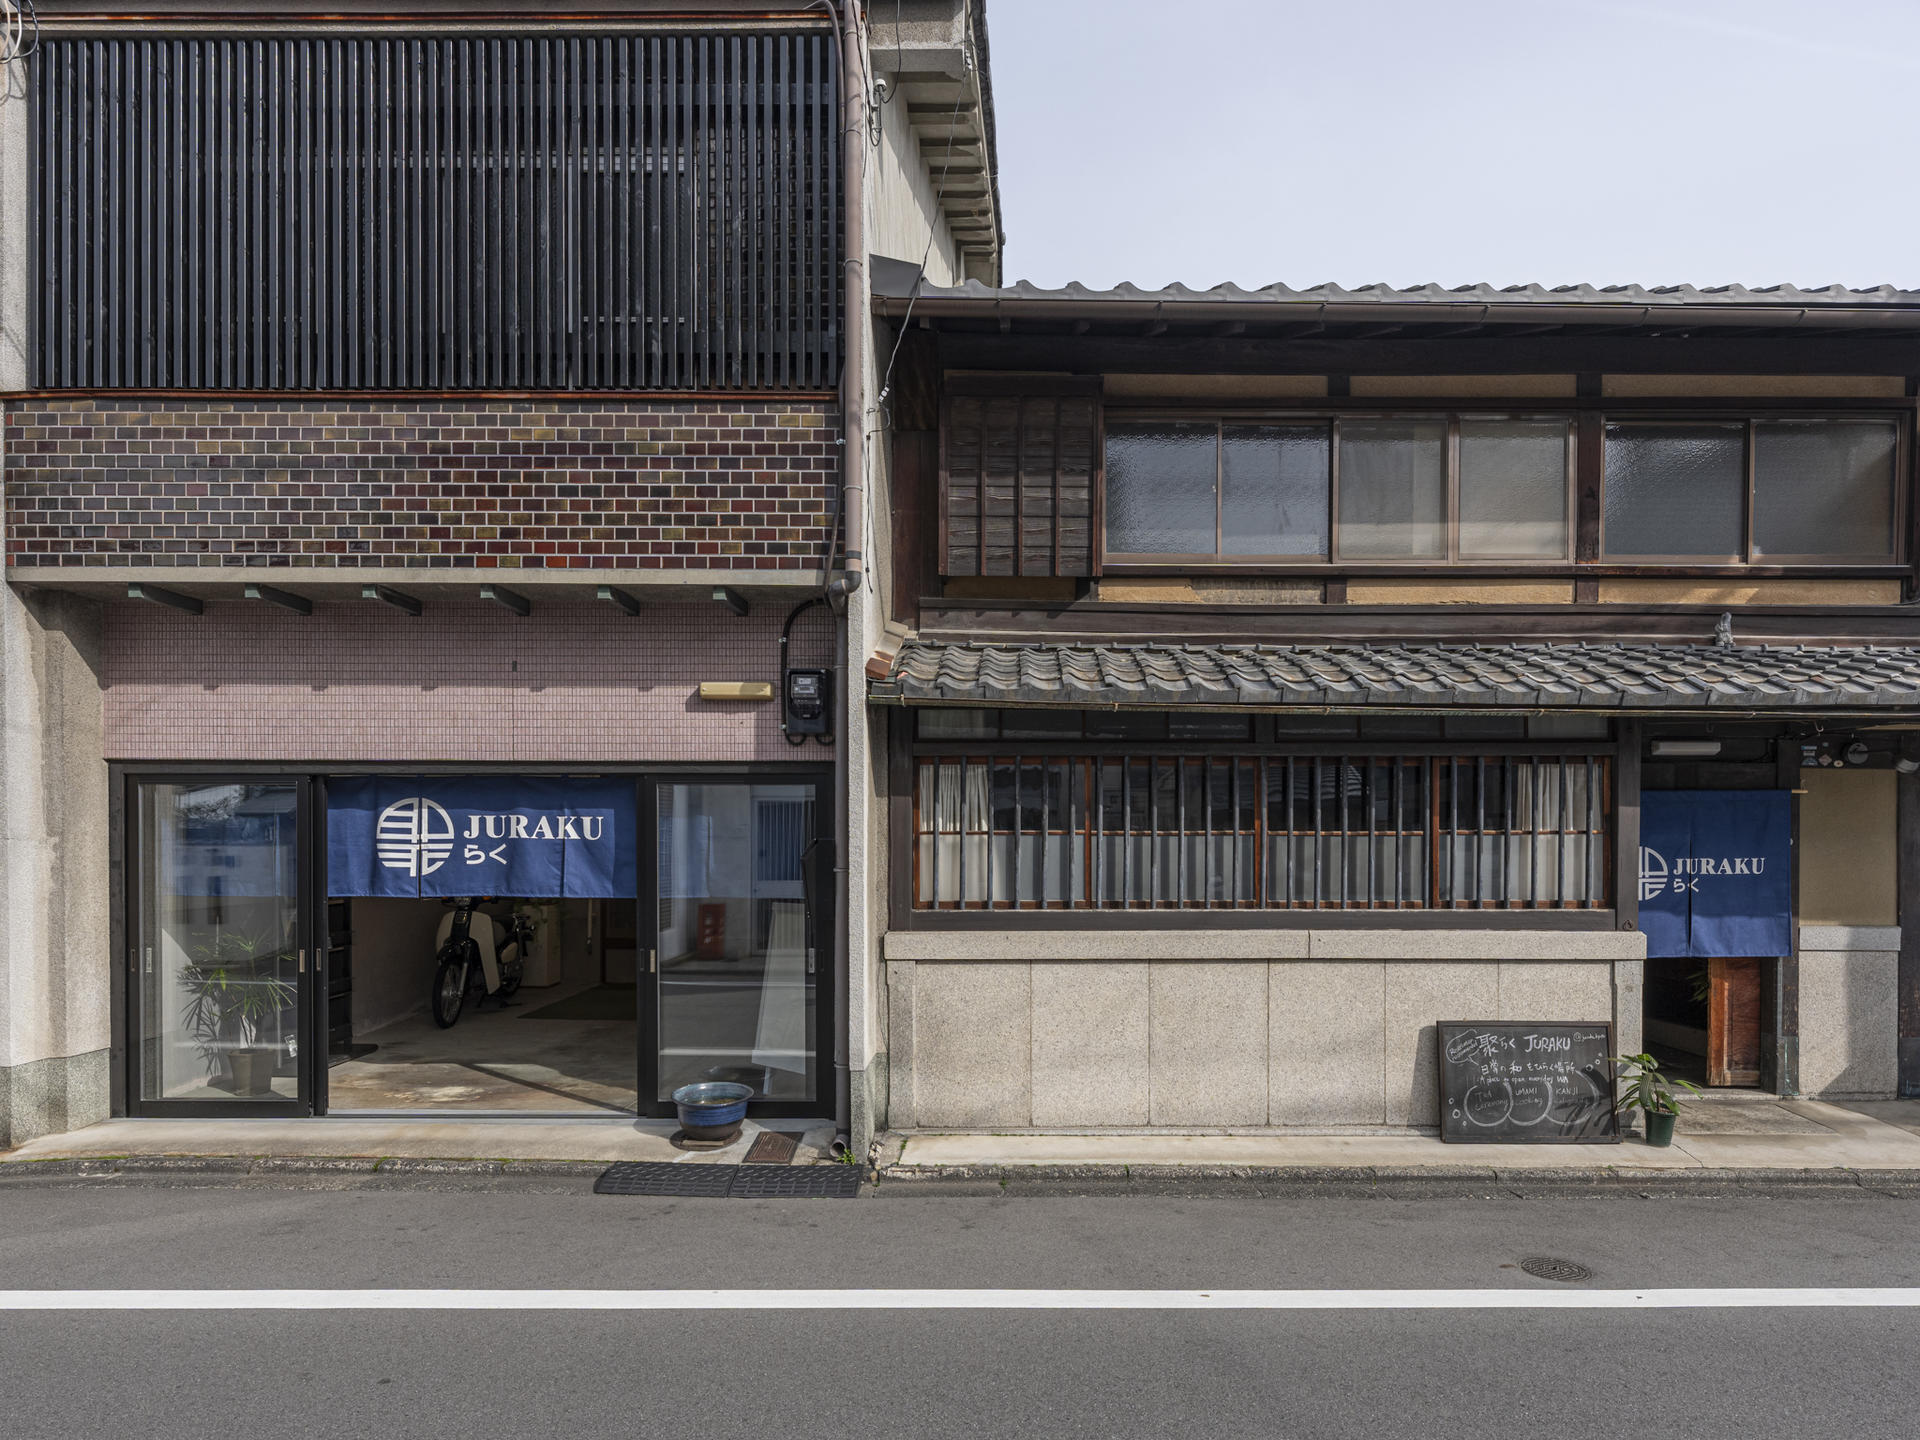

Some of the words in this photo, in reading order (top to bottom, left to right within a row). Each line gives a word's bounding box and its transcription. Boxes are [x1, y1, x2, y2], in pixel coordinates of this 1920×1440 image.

[463, 814, 605, 841] JURAKU
[464, 843, 508, 866] らく
[1673, 857, 1766, 875] JURAKU
[1673, 878, 1700, 893] らく
[1523, 1034, 1571, 1053] JURAKU
[1555, 1087, 1579, 1096] KANJI
